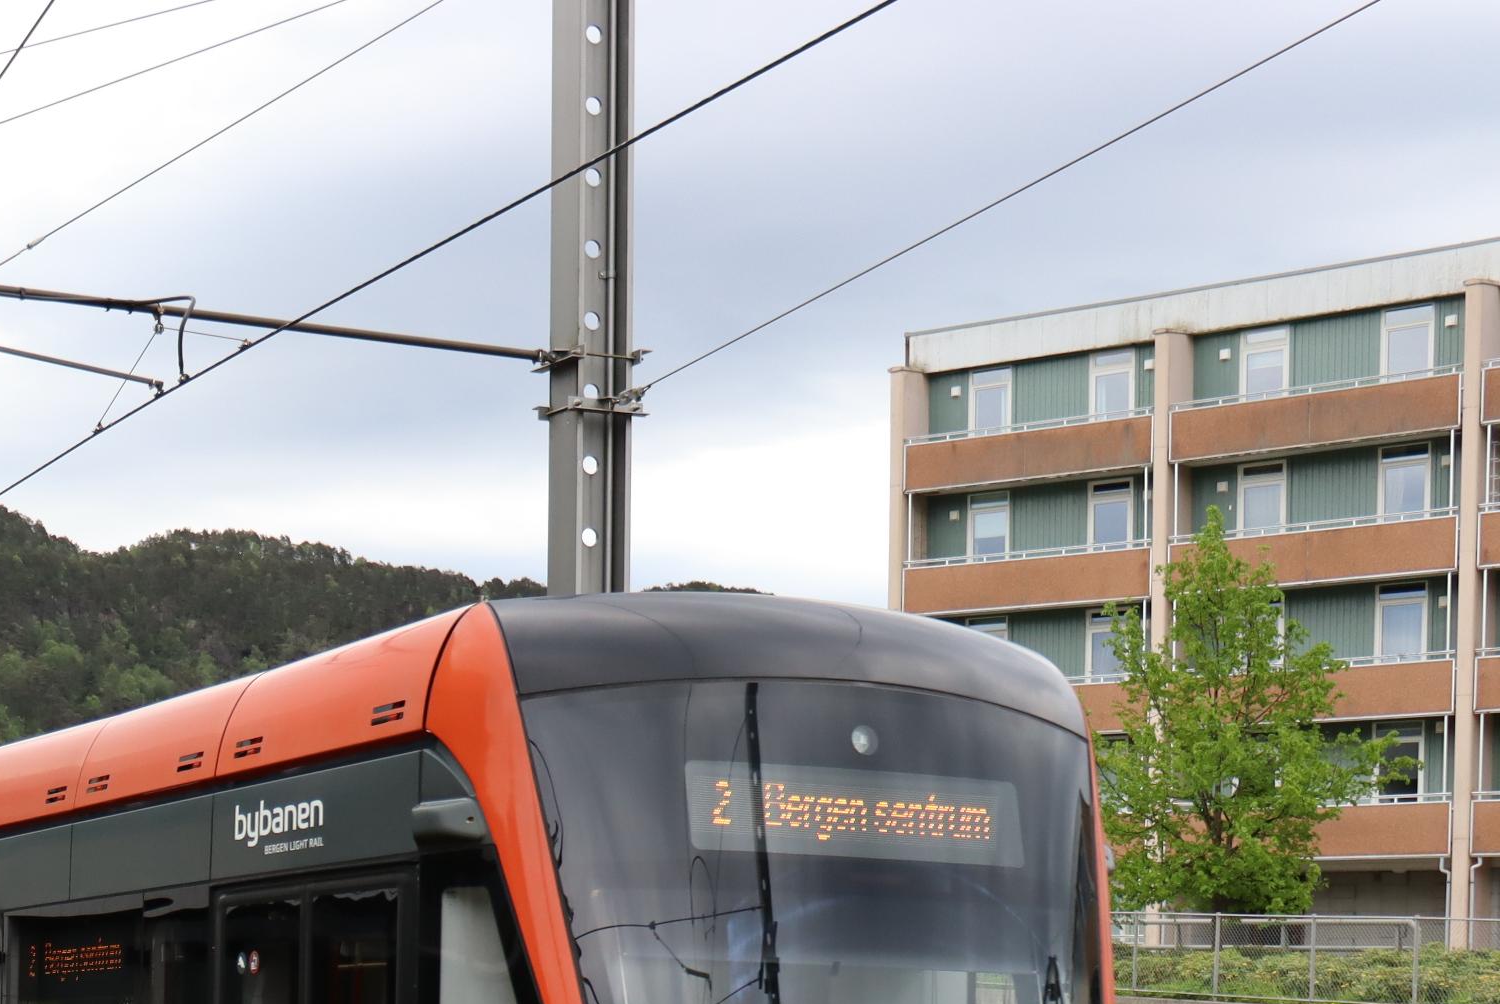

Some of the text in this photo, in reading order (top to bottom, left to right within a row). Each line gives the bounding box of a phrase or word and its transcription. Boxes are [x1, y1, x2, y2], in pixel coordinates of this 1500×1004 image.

[234, 799, 324, 848] bybanen
[712, 780, 991, 841] 2 Bergen sentrum
[264, 837, 324, 855] BERGEN LIGHT RAIL
